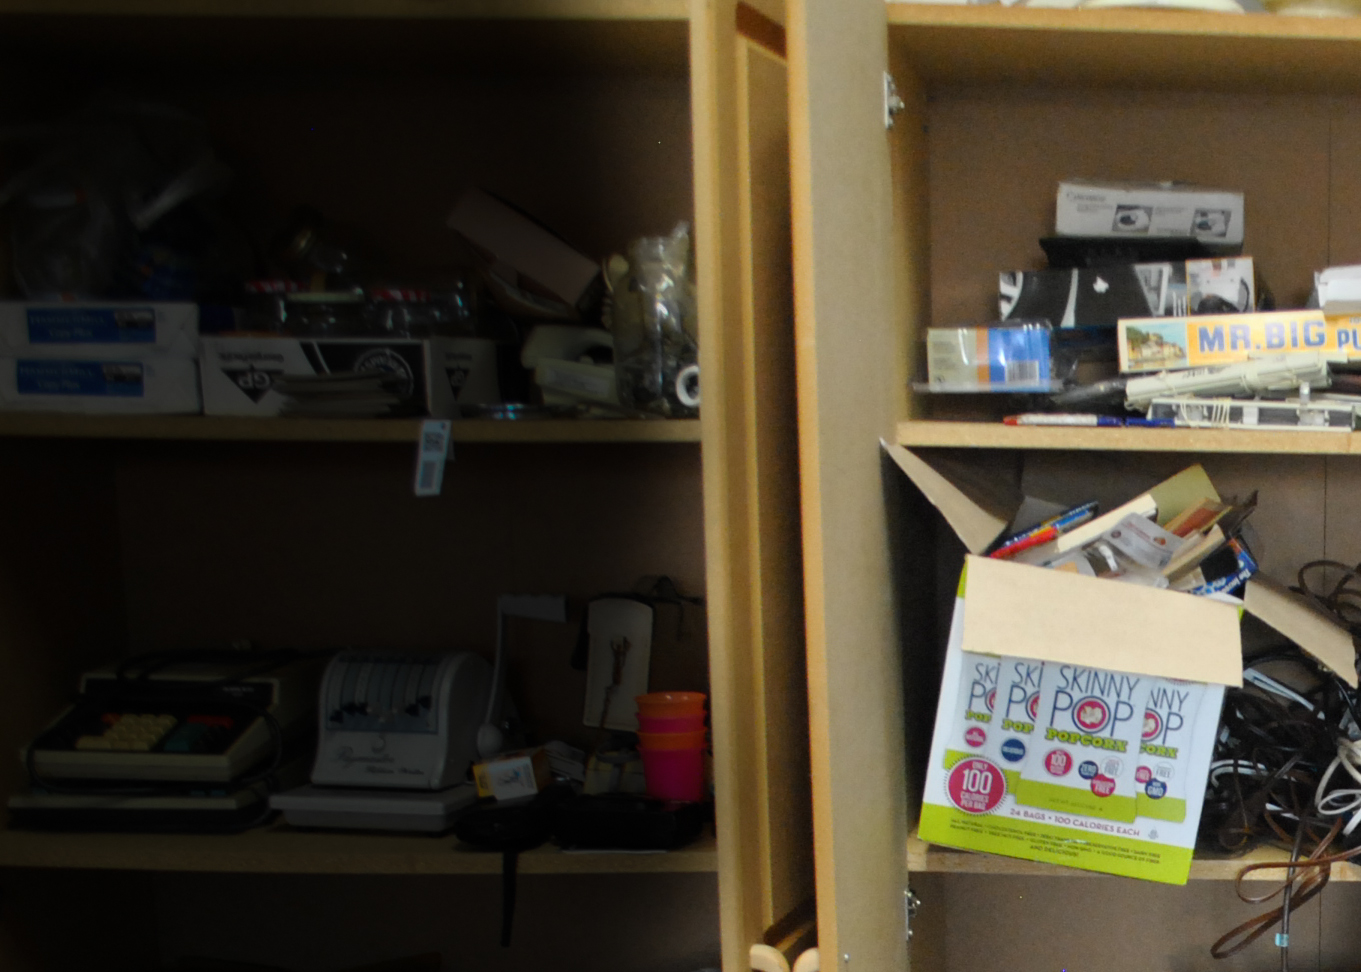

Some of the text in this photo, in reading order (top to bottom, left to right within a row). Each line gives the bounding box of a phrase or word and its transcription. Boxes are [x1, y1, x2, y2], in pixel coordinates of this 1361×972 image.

[1056, 665, 1140, 701] SKINNY
[1050, 690, 1134, 738] POP
[1044, 727, 1129, 753] POPCORN
[962, 768, 993, 794] 100
[1010, 808, 1140, 837] 24 BAGS 100 CALORIES EACH
